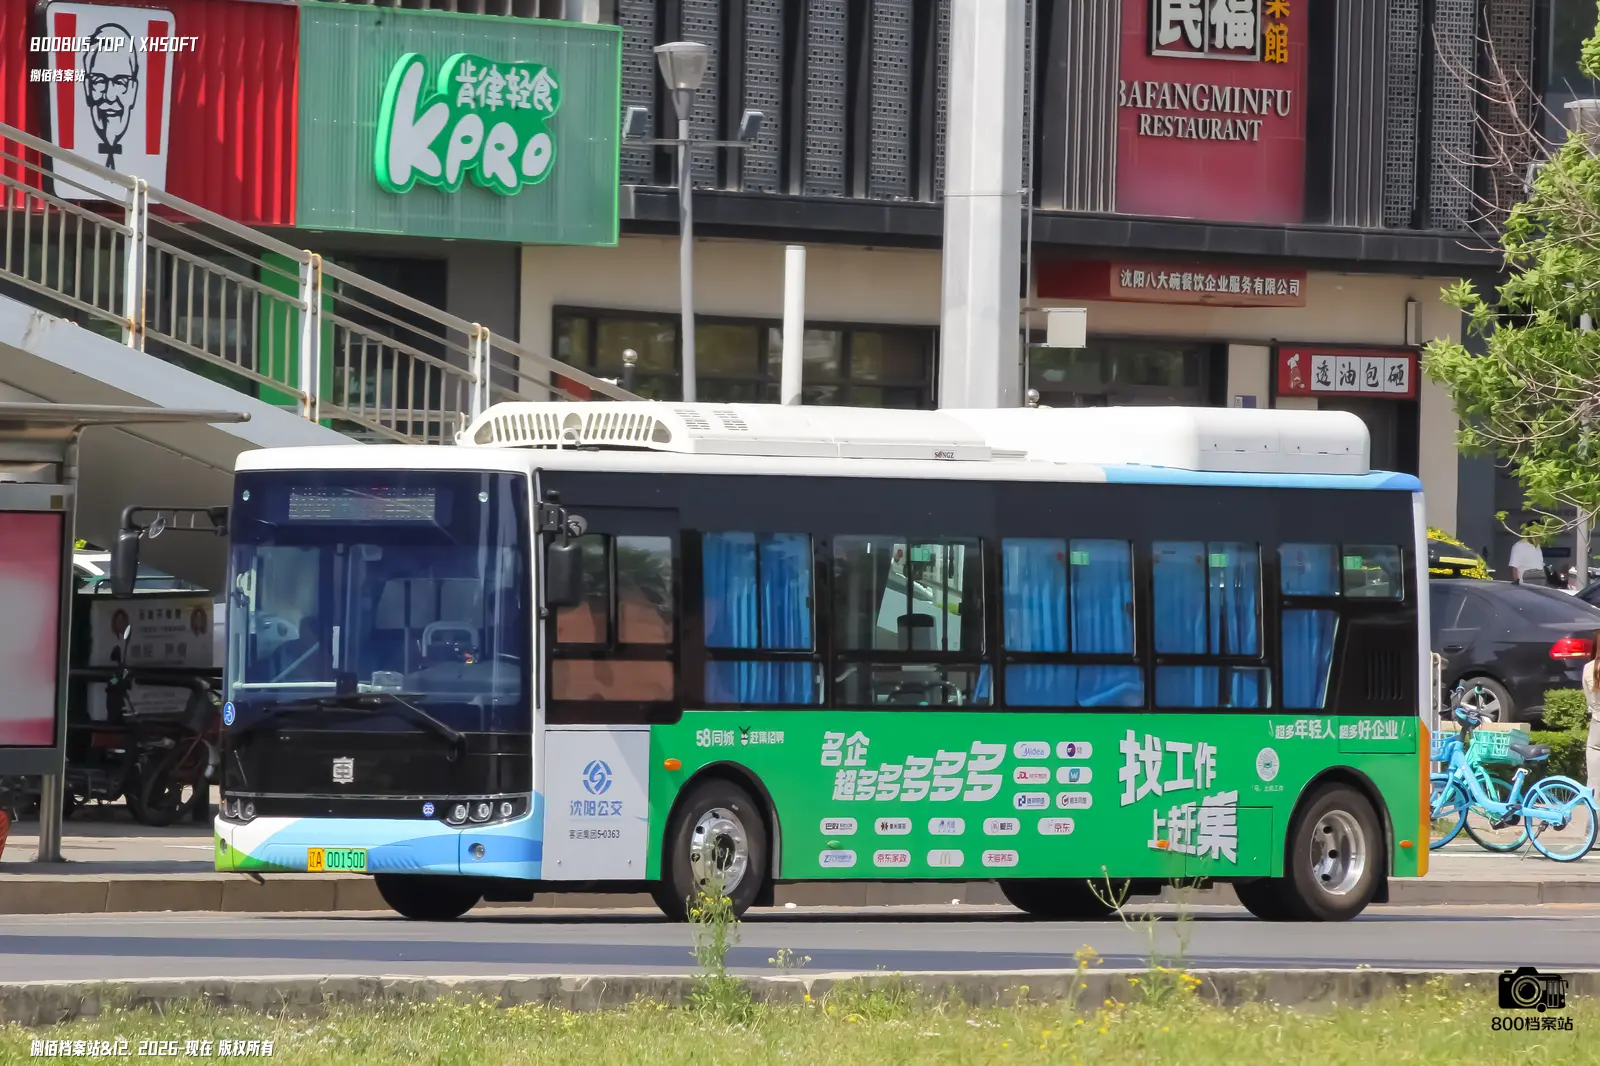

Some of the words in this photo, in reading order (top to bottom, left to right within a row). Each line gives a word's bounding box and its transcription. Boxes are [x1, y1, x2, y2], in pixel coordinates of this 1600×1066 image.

[1158, 0, 1255, 49] 民福
[455, 59, 559, 112] 肯律轻食
[388, 61, 552, 188] KPRO
[1139, 113, 1263, 142] RESTAURANT
[1120, 269, 1300, 296] 沈阳八大碗餐饮企业服务有限公司
[696, 728, 735, 748] 58同城
[750, 731, 785, 744] 赶集招聘
[820, 731, 870, 767] 名企
[1275, 719, 1336, 740] 超多年轻人
[1339, 719, 1399, 740] 超多好企业
[832, 740, 1007, 802] 超多多多多多
[1118, 729, 1217, 807] 找工作
[569, 800, 623, 817] 沈阳公交
[1147, 790, 1239, 864] 上赶集
